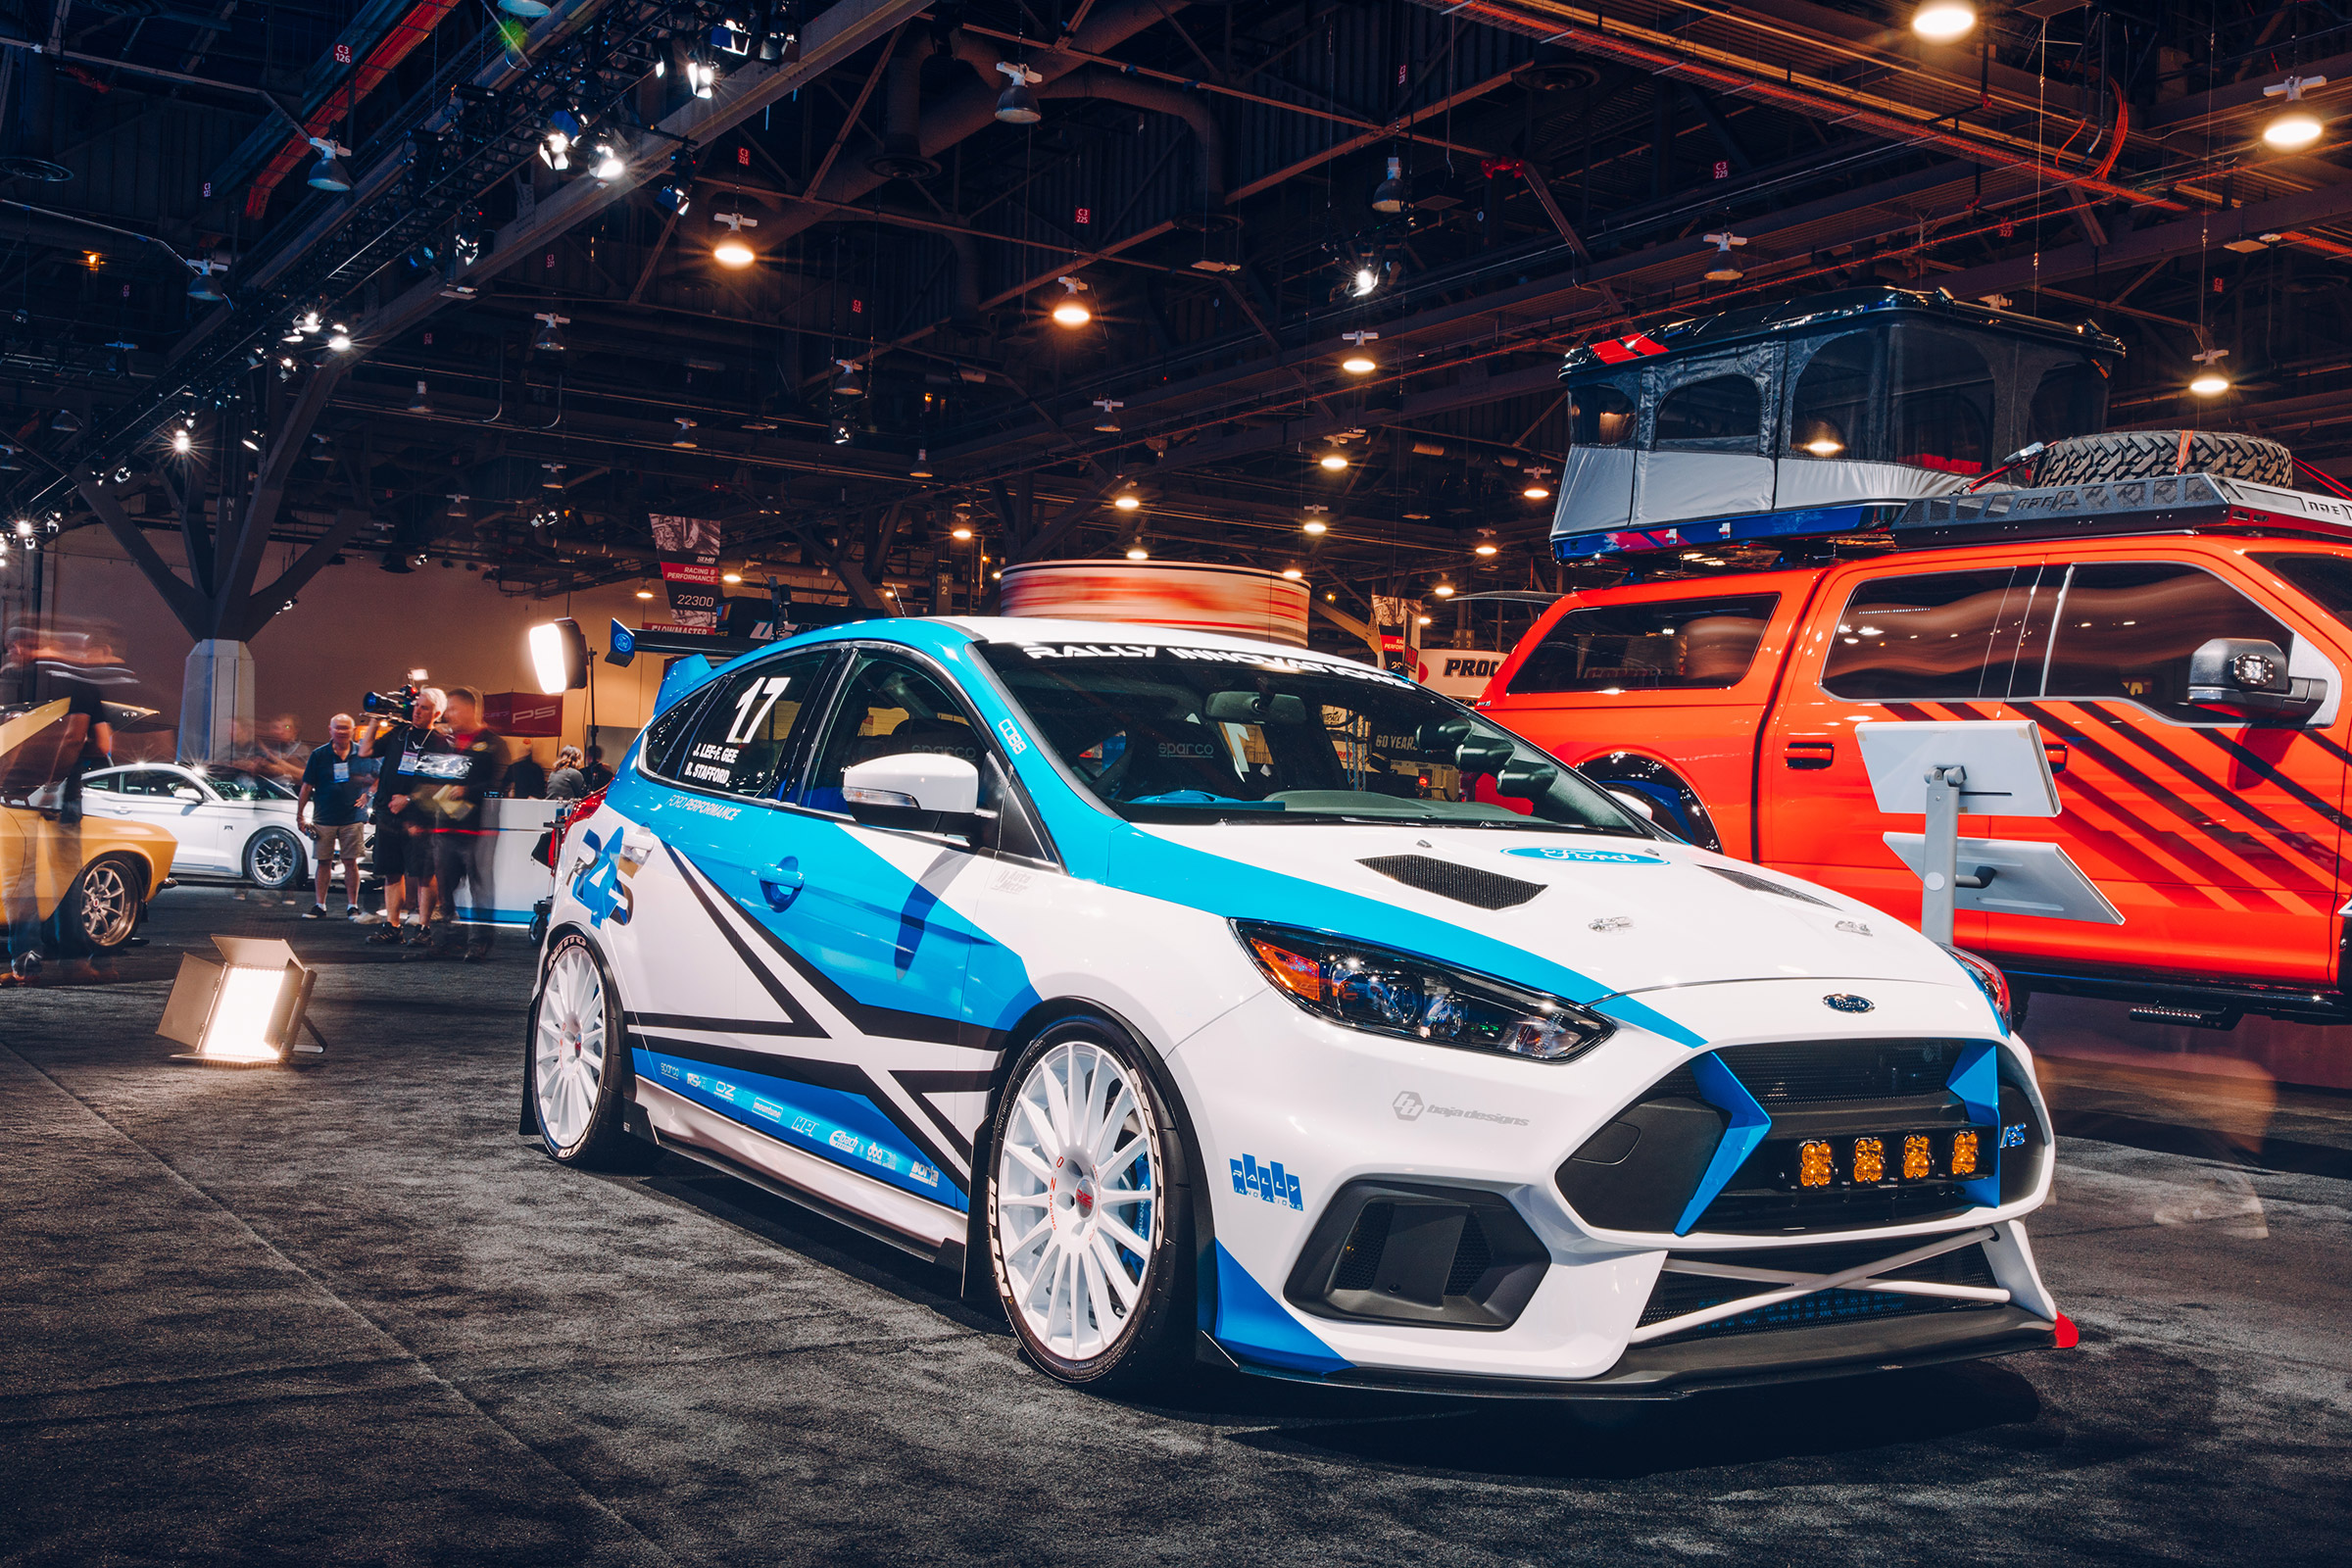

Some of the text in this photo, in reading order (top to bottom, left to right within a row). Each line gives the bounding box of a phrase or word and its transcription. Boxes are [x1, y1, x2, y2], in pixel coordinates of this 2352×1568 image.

[335, 53, 351, 64] 126
[1715, 171, 1729, 179] 229
[667, 571, 715, 583] PERFORMANCE
[684, 566, 709, 575] RACING
[677, 594, 714, 608] 22300
[1022, 645, 1156, 660] RALLY
[1165, 647, 1416, 691] INNOVATIONS
[725, 676, 791, 744] 17
[998, 718, 1027, 756] COBB
[1375, 734, 1389, 748] 60
[692, 742, 700, 757] J.
[721, 747, 740, 764] GEE
[1158, 741, 1214, 759] sparco
[684, 761, 731, 785] B. STAFFORD
[665, 794, 742, 821] FORD PERFORMANCE
[1540, 848, 1638, 863] Ford
[661, 1061, 680, 1078] sparco
[715, 1080, 737, 1098] OZ
[754, 1101, 782, 1118] mountune
[1427, 1103, 1464, 1118] baja
[1464, 1109, 1530, 1127] designs
[829, 1130, 859, 1149] Eibach
[1999, 1122, 2028, 1149] RS
[867, 1141, 883, 1160] dba
[1232, 1169, 1298, 1193] RALLY
[1235, 1186, 1302, 1211] INNOVATIONS
